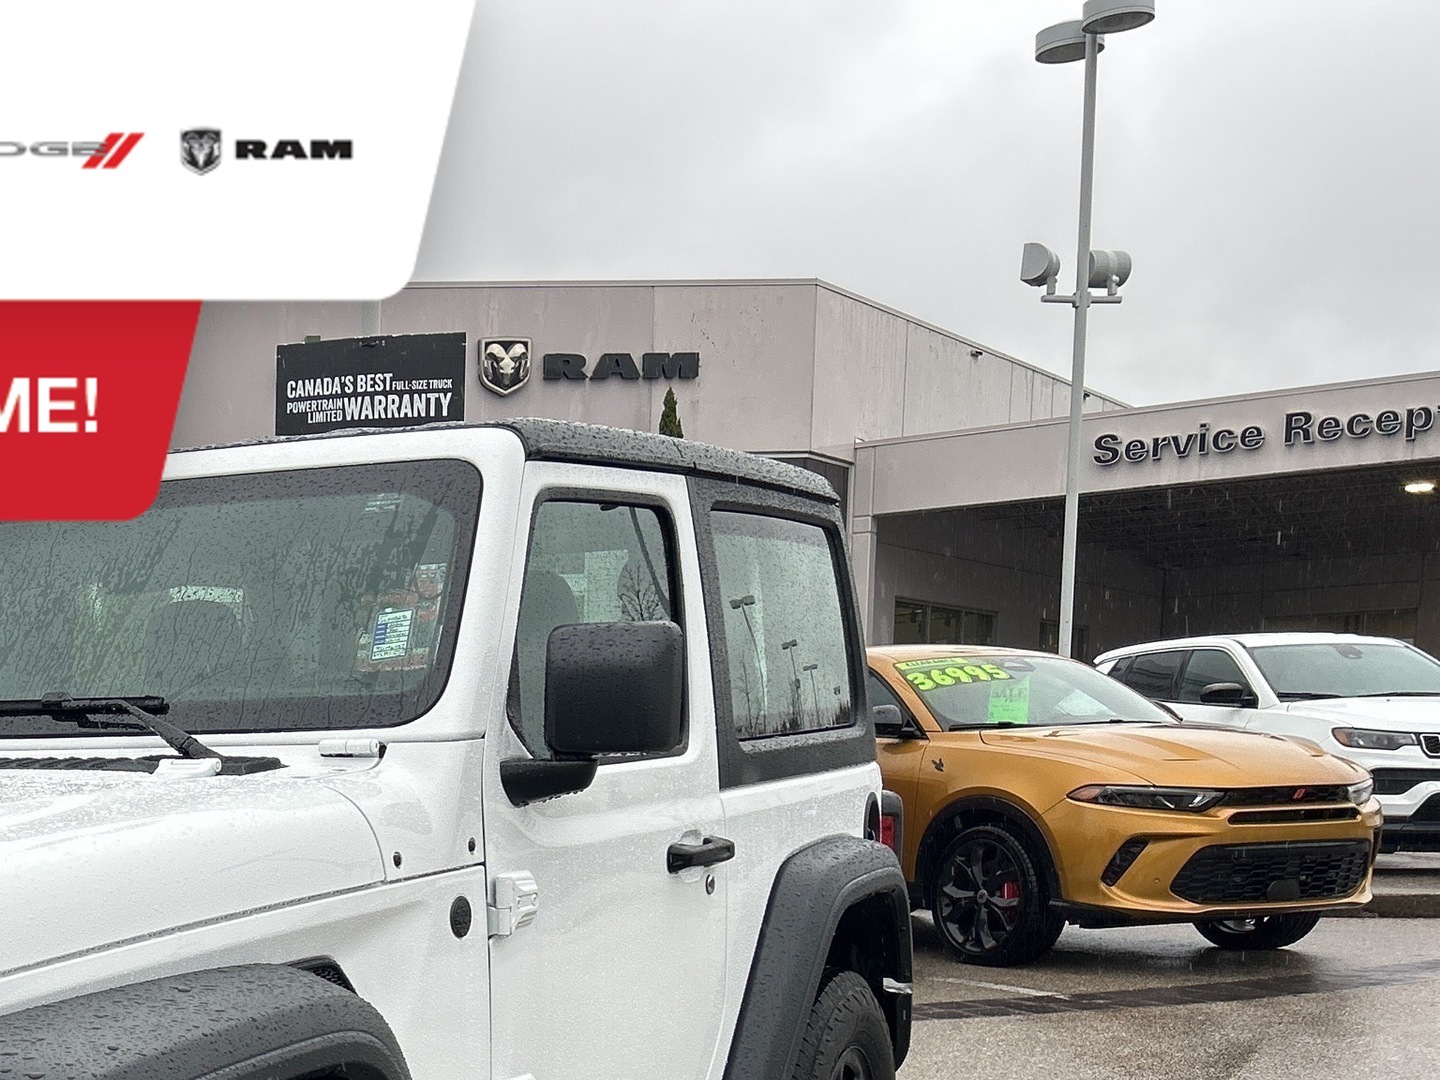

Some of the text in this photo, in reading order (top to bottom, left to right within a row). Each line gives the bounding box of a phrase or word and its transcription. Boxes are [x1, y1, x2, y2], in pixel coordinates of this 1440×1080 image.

[543, 352, 700, 380] RAM
[286, 372, 453, 399] CANADA'S BEST FULL-SIZE TRUCK
[286, 392, 453, 421] POWERTRAIN WARRANTY
[307, 410, 343, 424] LIMITED
[1092, 404, 1440, 467] Service Recep
[906, 664, 1010, 691] 36995
